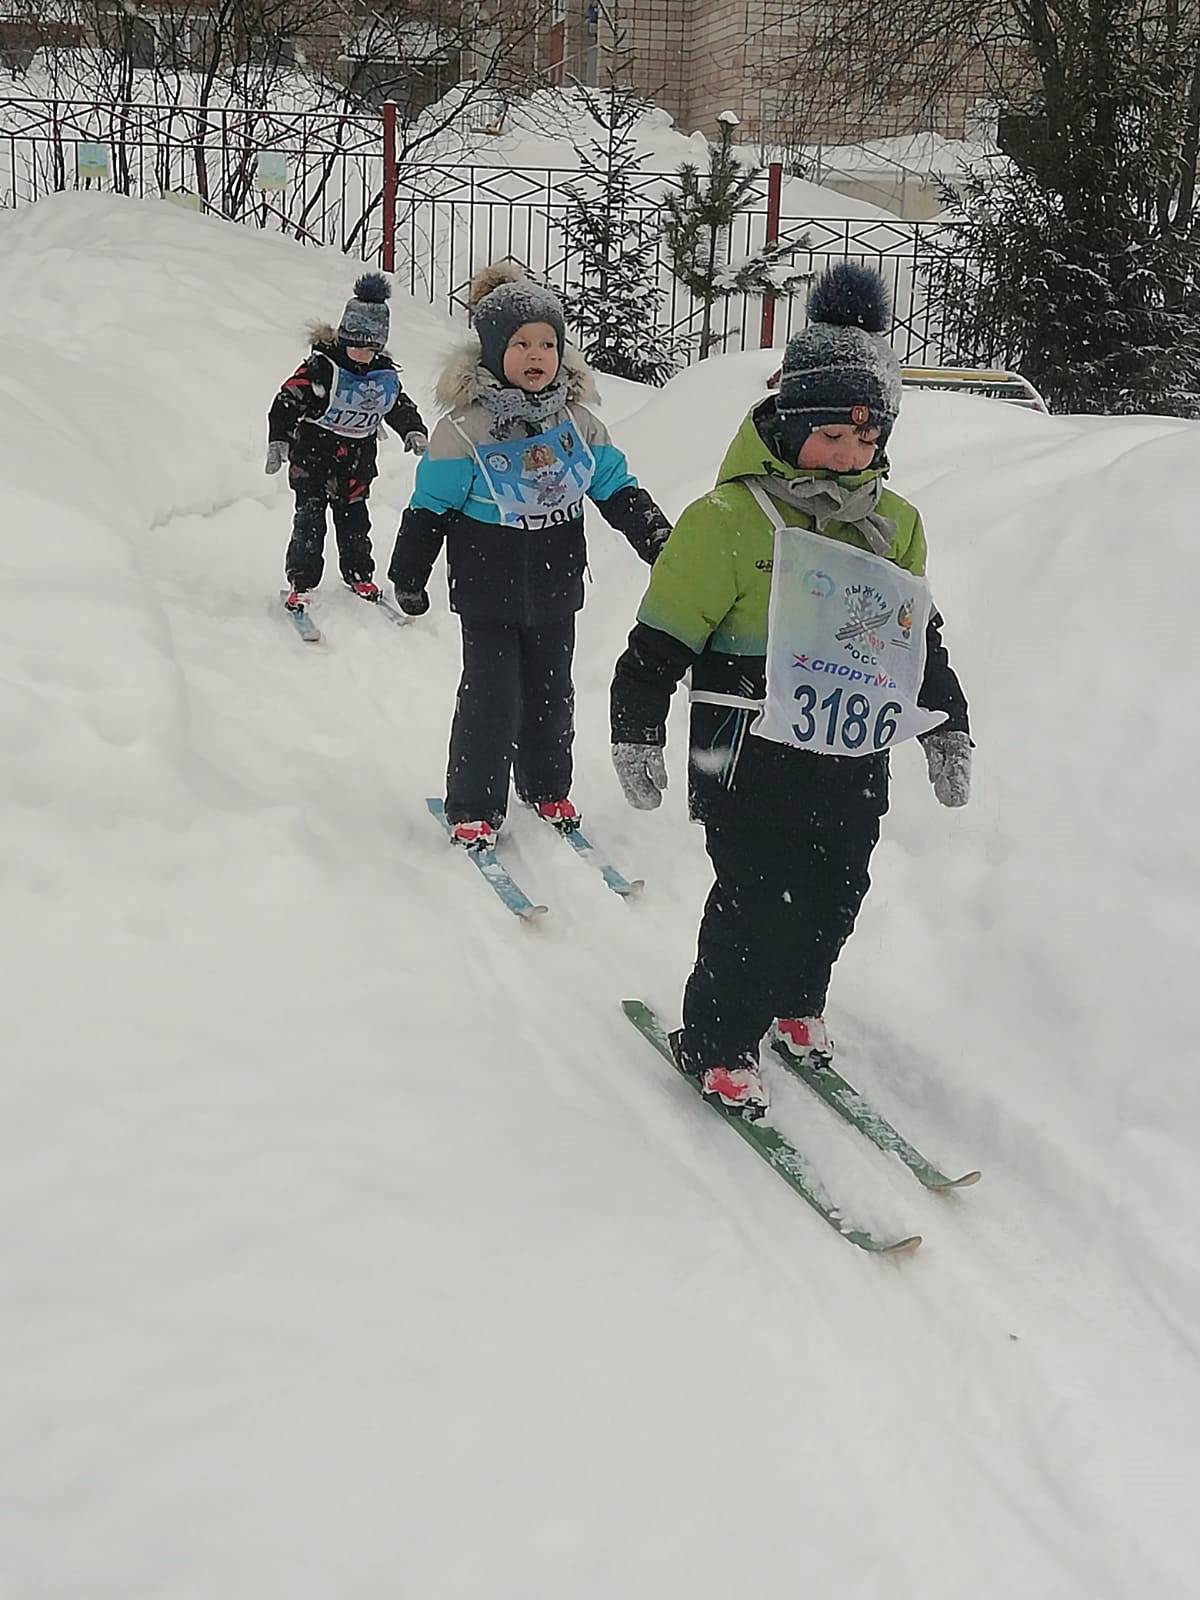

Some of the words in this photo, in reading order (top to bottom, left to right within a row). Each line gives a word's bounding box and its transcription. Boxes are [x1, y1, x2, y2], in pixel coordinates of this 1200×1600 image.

[516, 501, 579, 530] 178
[845, 584, 887, 610] ЛЫЖНЯ
[791, 684, 903, 749] 3186
